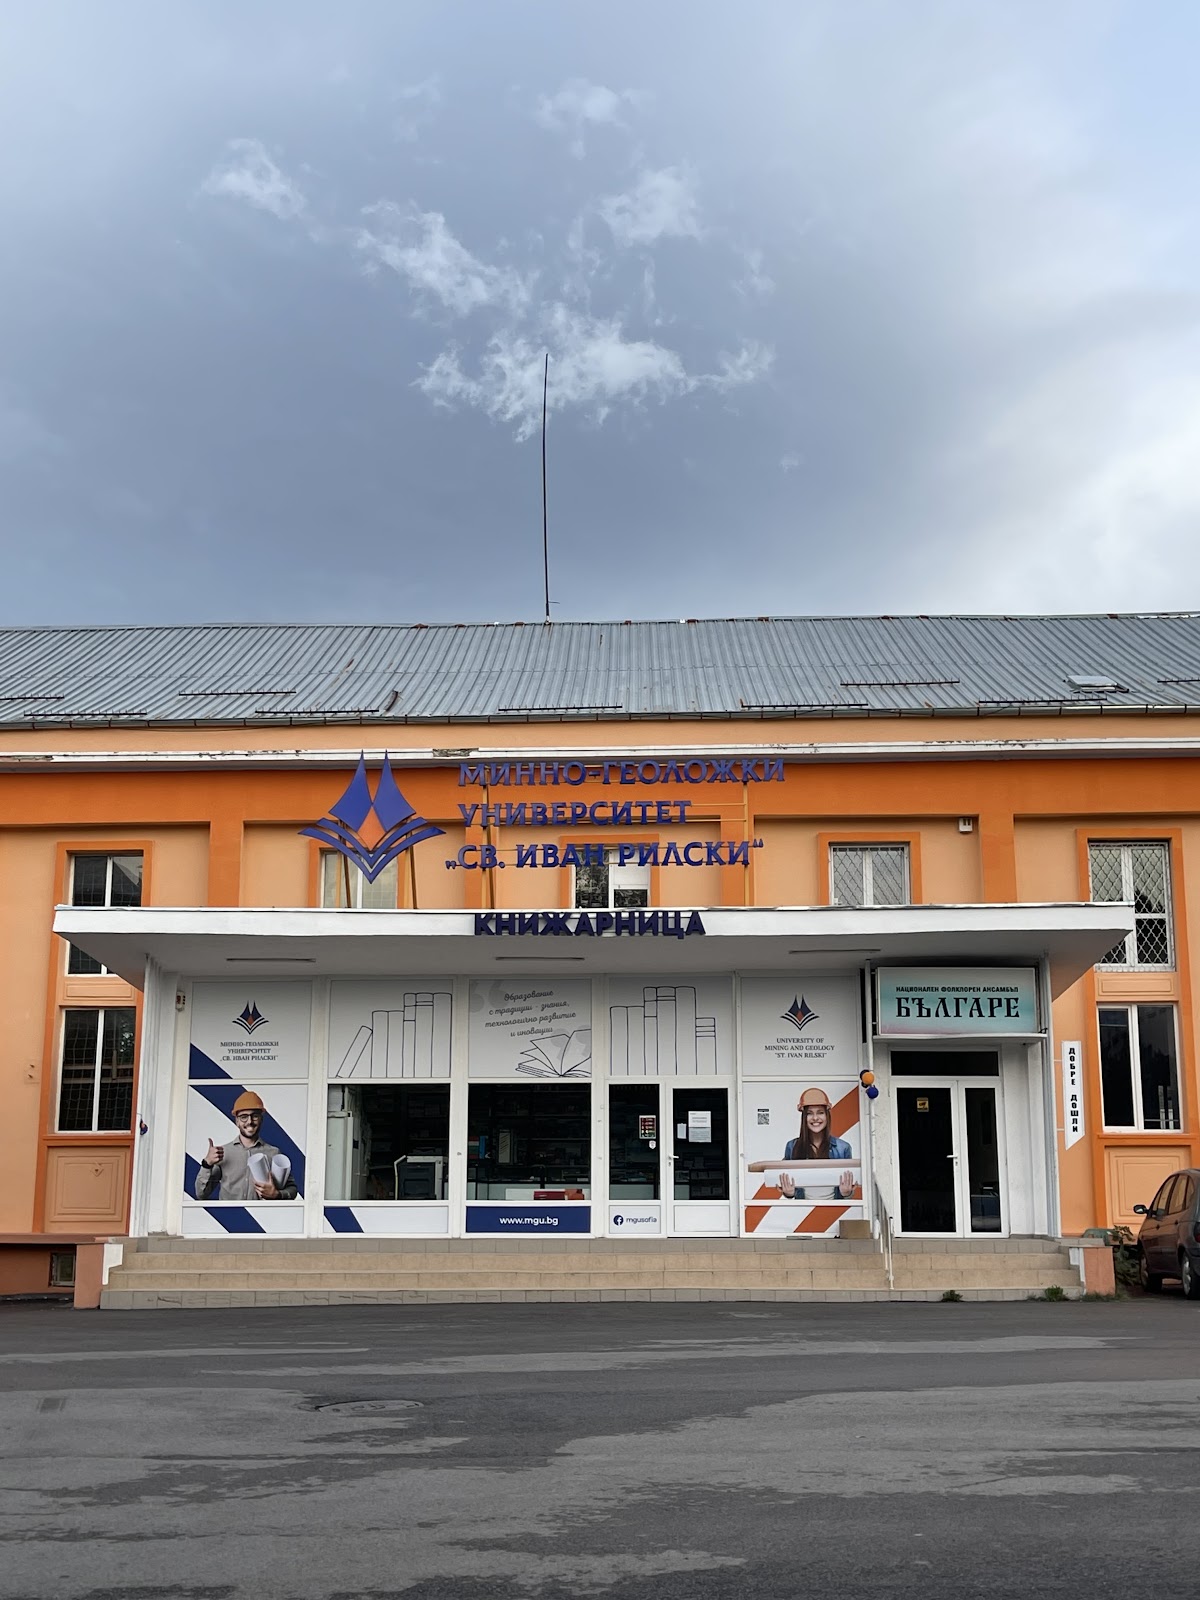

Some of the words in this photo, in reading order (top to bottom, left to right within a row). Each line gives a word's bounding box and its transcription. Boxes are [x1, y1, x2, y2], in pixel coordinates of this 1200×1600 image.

[458, 759, 786, 787] МИННО-ГЕОЛОЖКИ
[457, 801, 692, 827] УНИВЕРСИТЕТ
[516, 844, 605, 868] ИВАН
[474, 911, 706, 939] КНИЖАРНИЦА
[504, 990, 554, 1002] Образование
[495, 1005, 532, 1016] традиции
[896, 997, 1020, 1018] БЪЛГАРЕ
[539, 1012, 576, 1024] развитие
[517, 1027, 553, 1036] иновации
[1070, 1094, 1079, 1133] ДОШЛИ
[499, 1216, 559, 1226] www.mgu.bg
[625, 1216, 657, 1224] mgusofia
